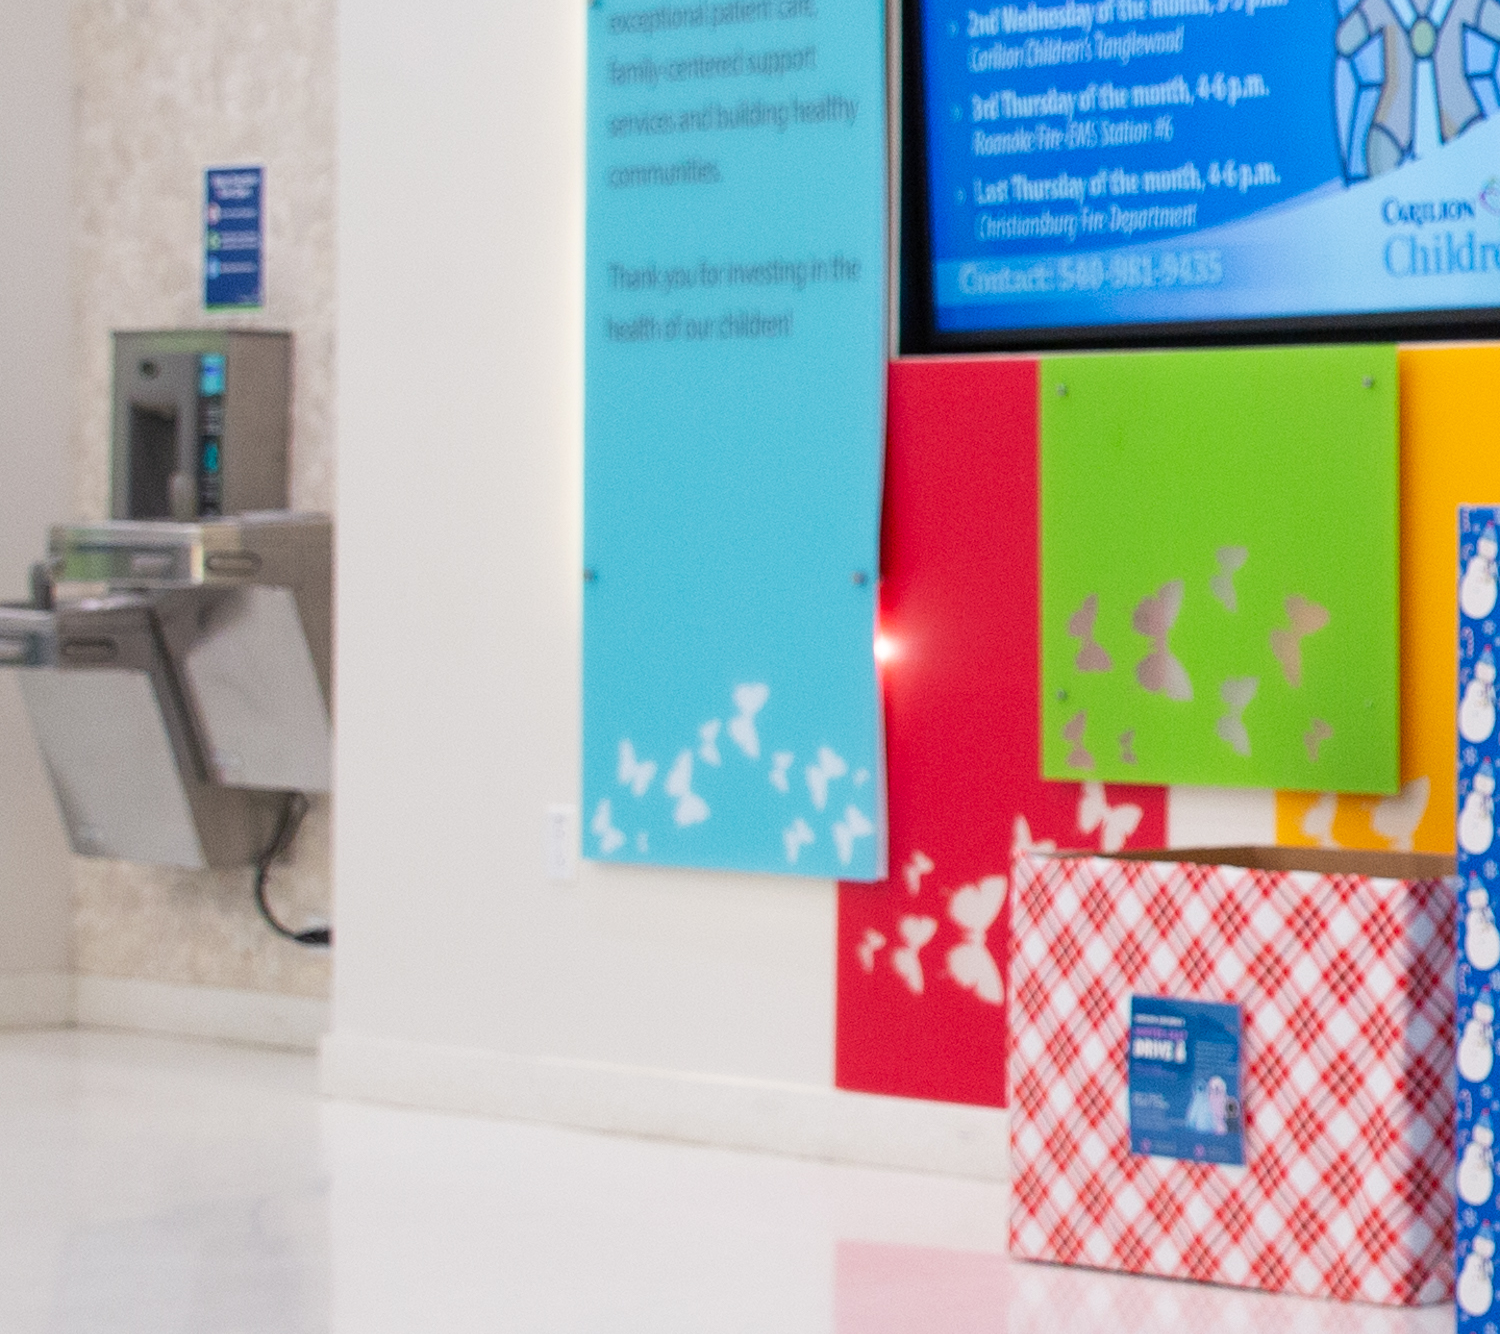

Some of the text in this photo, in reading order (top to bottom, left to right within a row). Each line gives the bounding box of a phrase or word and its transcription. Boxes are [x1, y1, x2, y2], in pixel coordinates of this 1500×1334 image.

[1001, 85, 1077, 120] Thursday
[1078, 81, 1098, 112] of
[1099, 79, 1129, 110] the
[1131, 73, 1194, 107] month,
[973, 177, 1008, 206] Last
[1010, 170, 1088, 205] Thursday
[1089, 168, 1107, 197] of
[1109, 166, 1140, 196] the
[1142, 160, 1205, 193] month,
